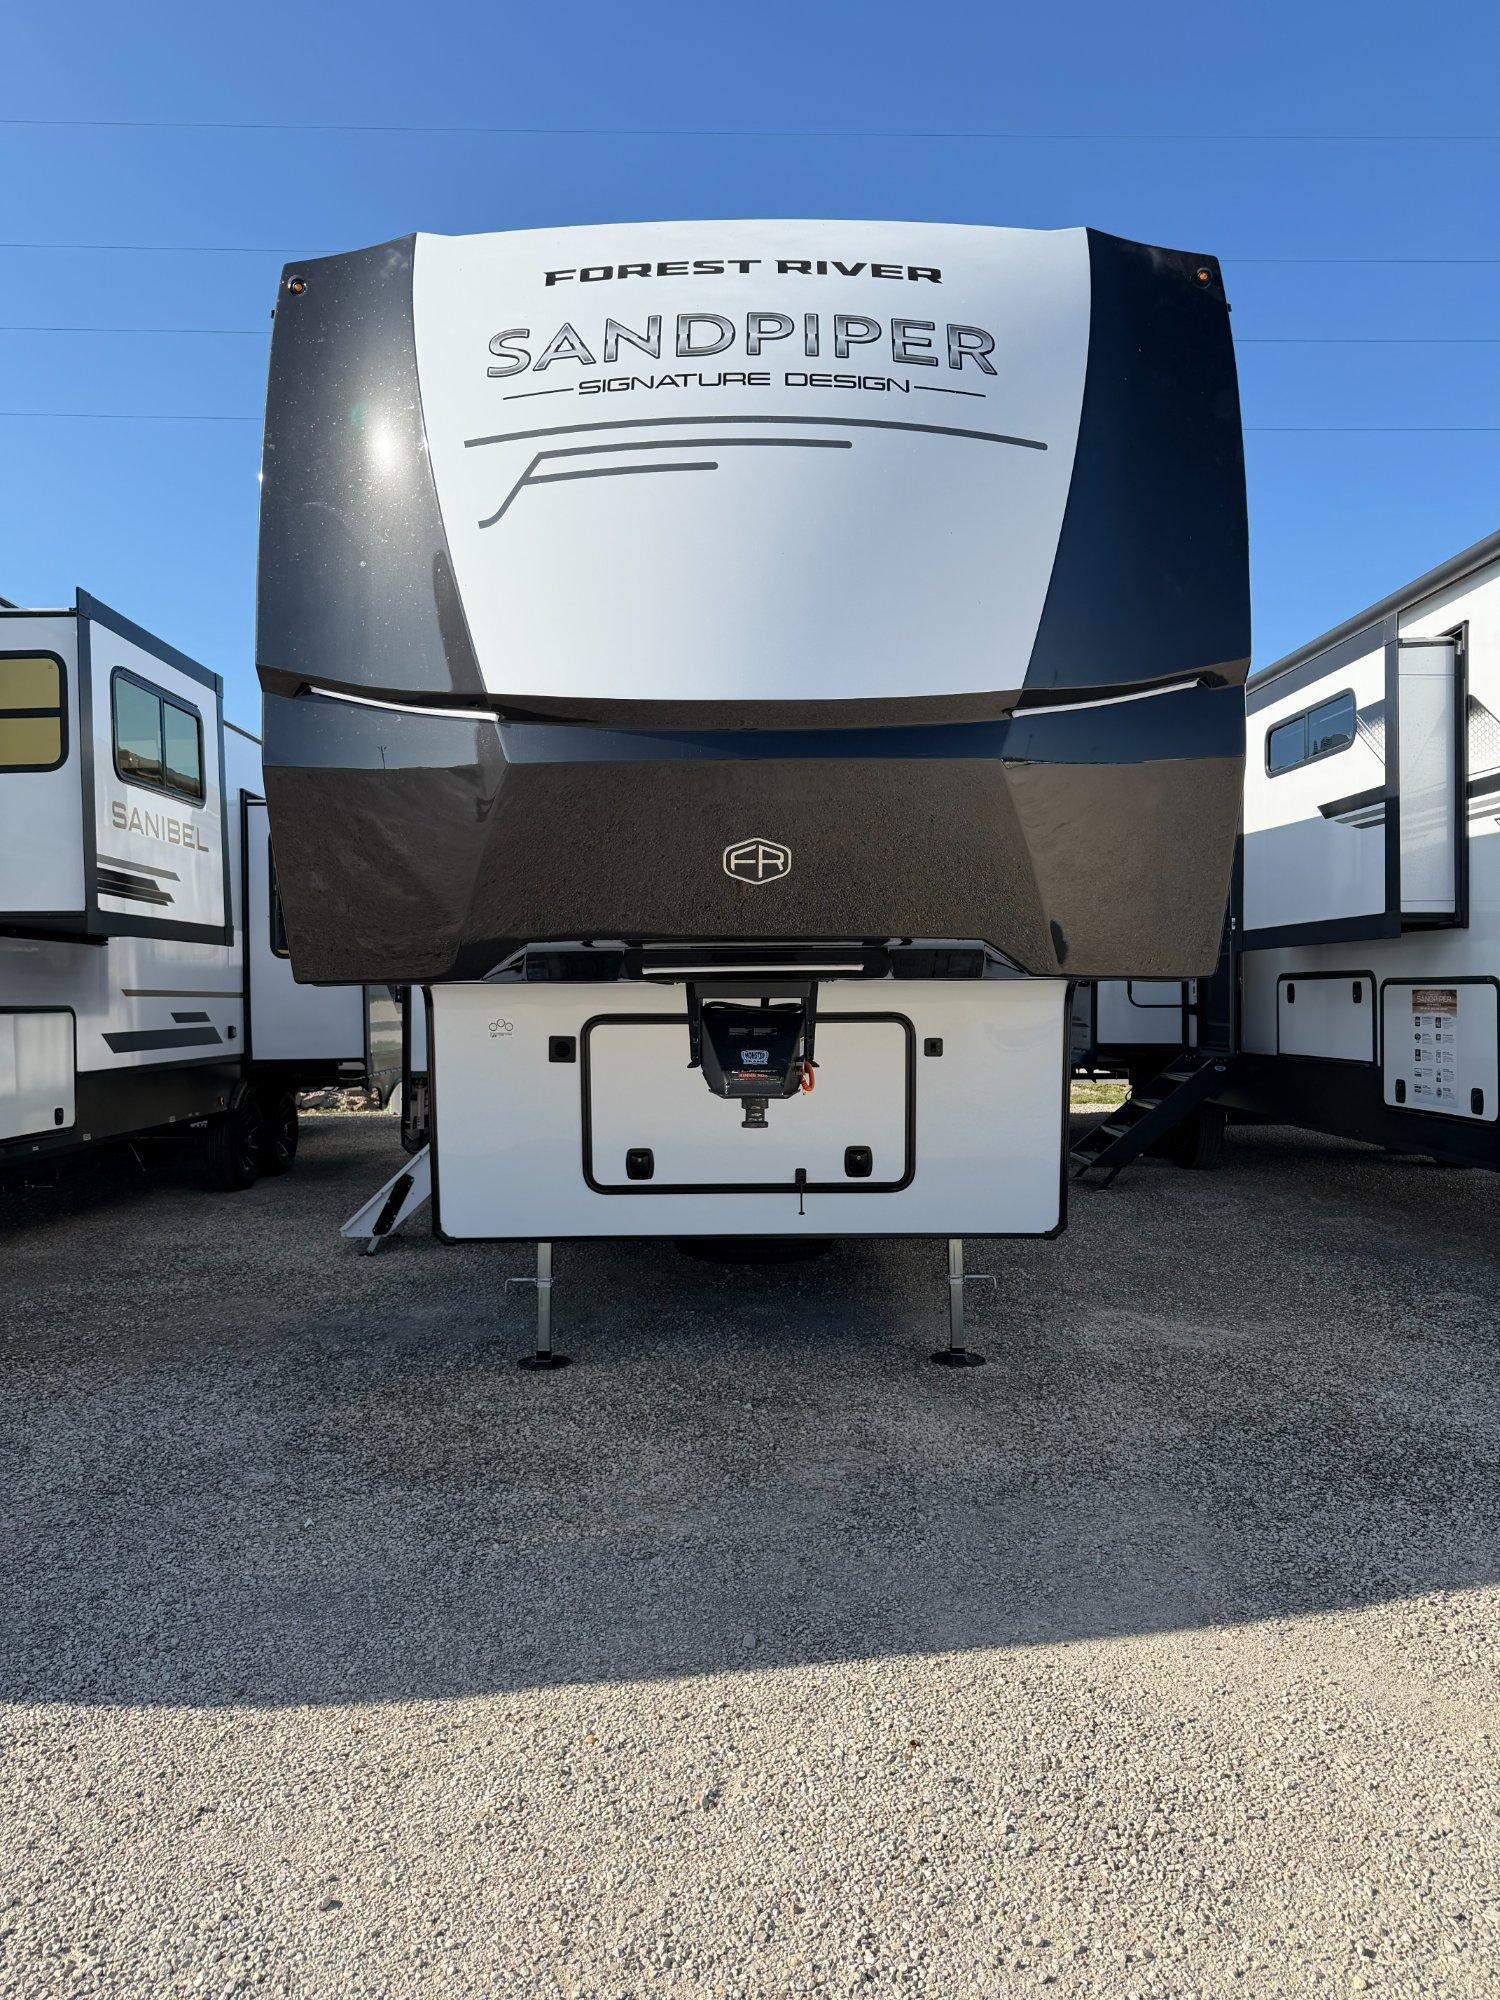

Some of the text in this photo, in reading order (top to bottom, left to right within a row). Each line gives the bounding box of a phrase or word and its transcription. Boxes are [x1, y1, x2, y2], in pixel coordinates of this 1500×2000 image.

[544, 260, 943, 286] FOREST RIVER
[487, 311, 998, 378] SANDPIPER
[578, 371, 910, 396] SIGNATURE DESIGN
[111, 800, 210, 852] SANIBEL
[731, 844, 784, 878] FR
